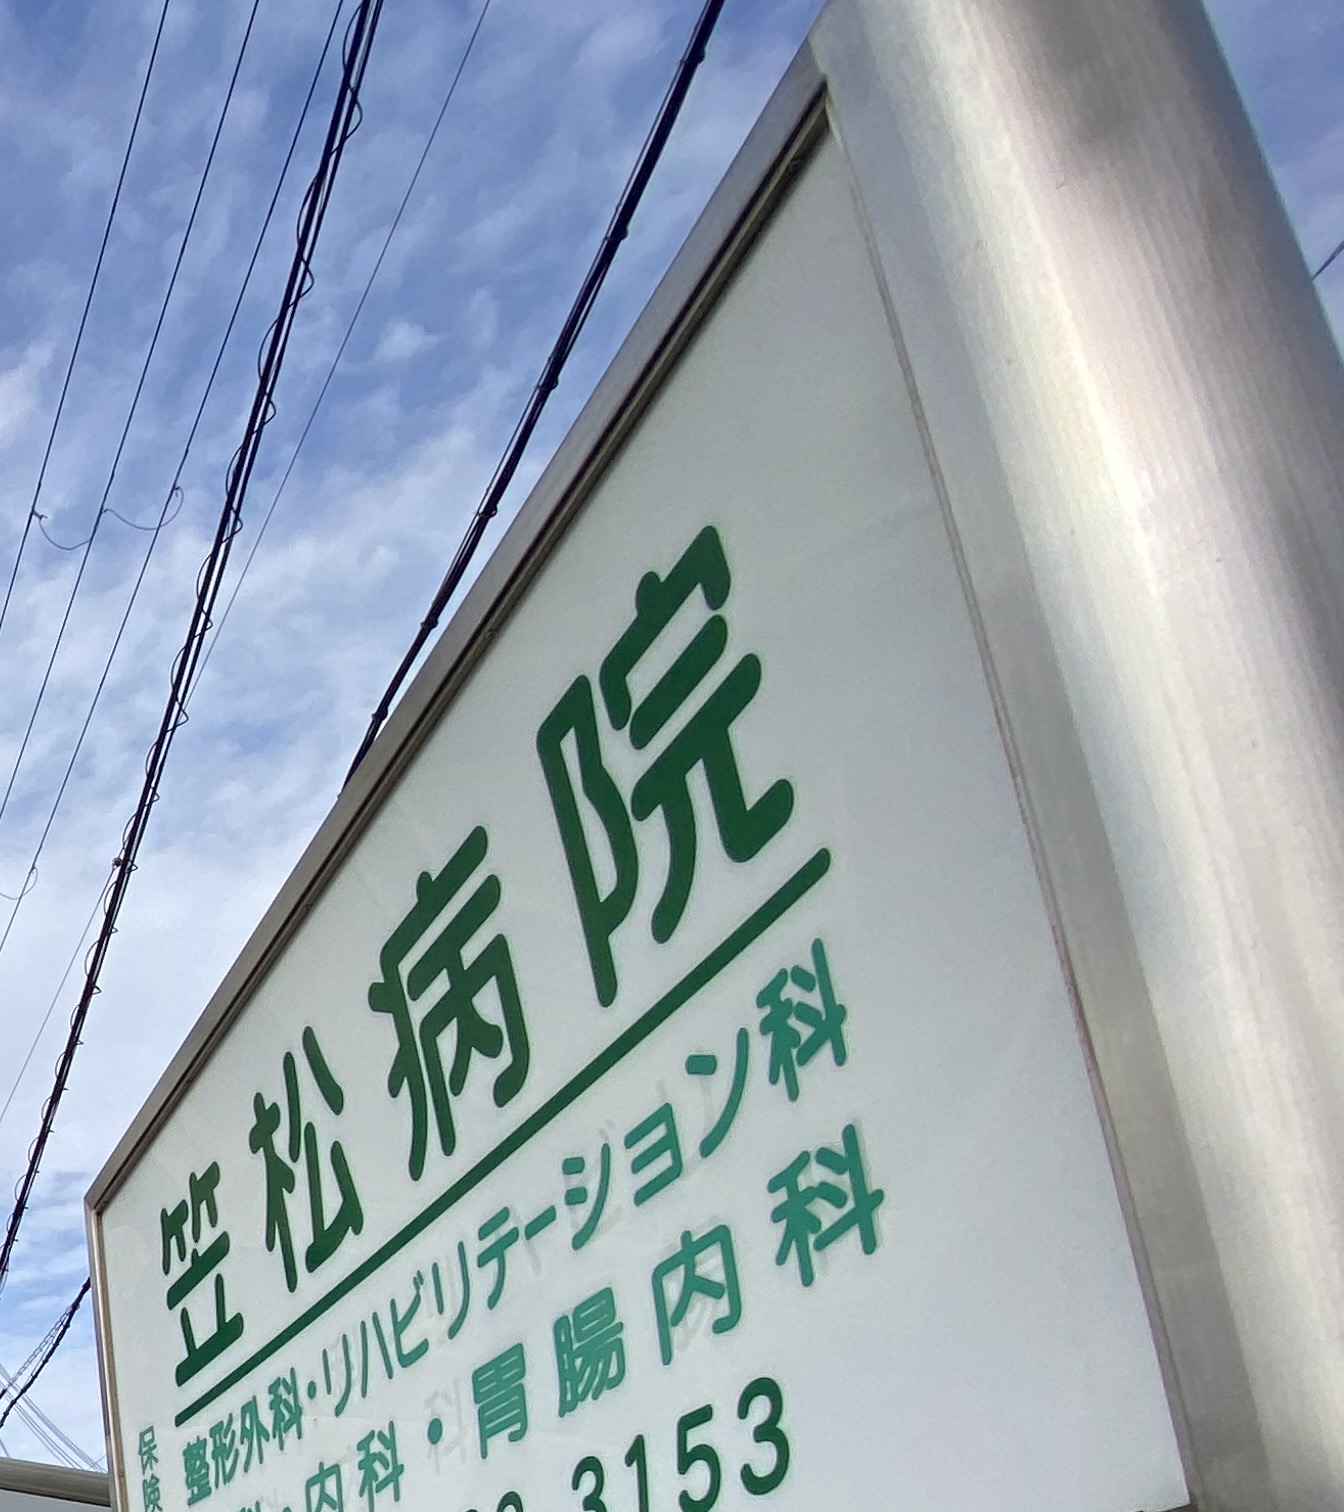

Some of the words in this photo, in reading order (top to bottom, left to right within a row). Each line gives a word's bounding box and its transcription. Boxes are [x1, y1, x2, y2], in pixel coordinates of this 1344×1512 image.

[160, 524, 796, 1387] 笠松病院
[181, 938, 850, 1507] 整形外科・リハビリテーション科
